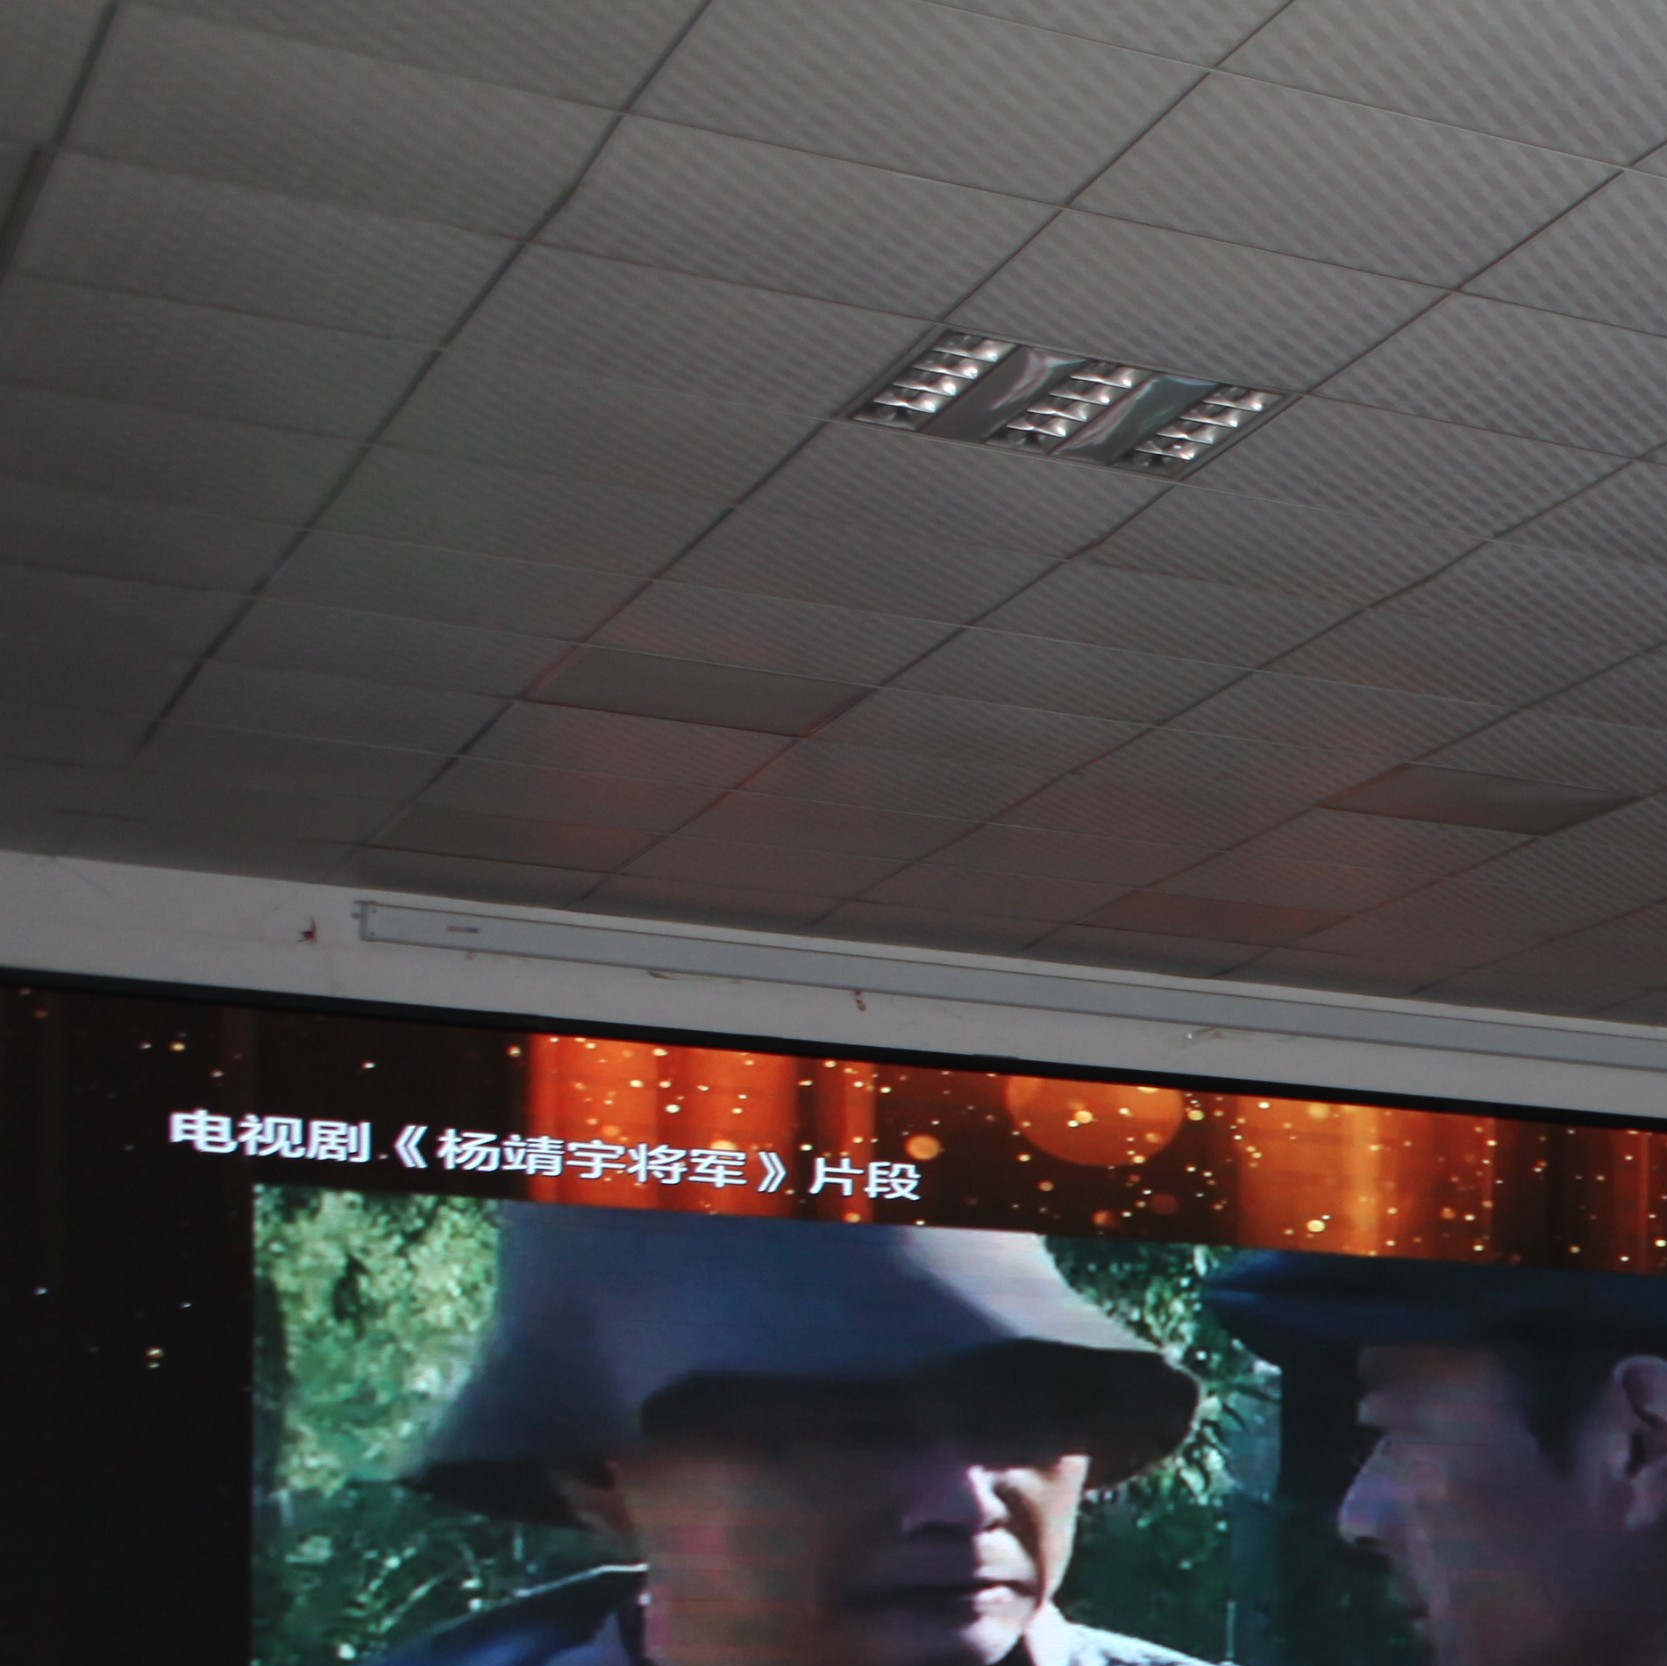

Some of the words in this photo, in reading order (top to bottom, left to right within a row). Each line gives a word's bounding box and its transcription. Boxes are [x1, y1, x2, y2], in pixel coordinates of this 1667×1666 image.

[169, 1108, 922, 1200] 电视剧《杨靖宇将军》片段
